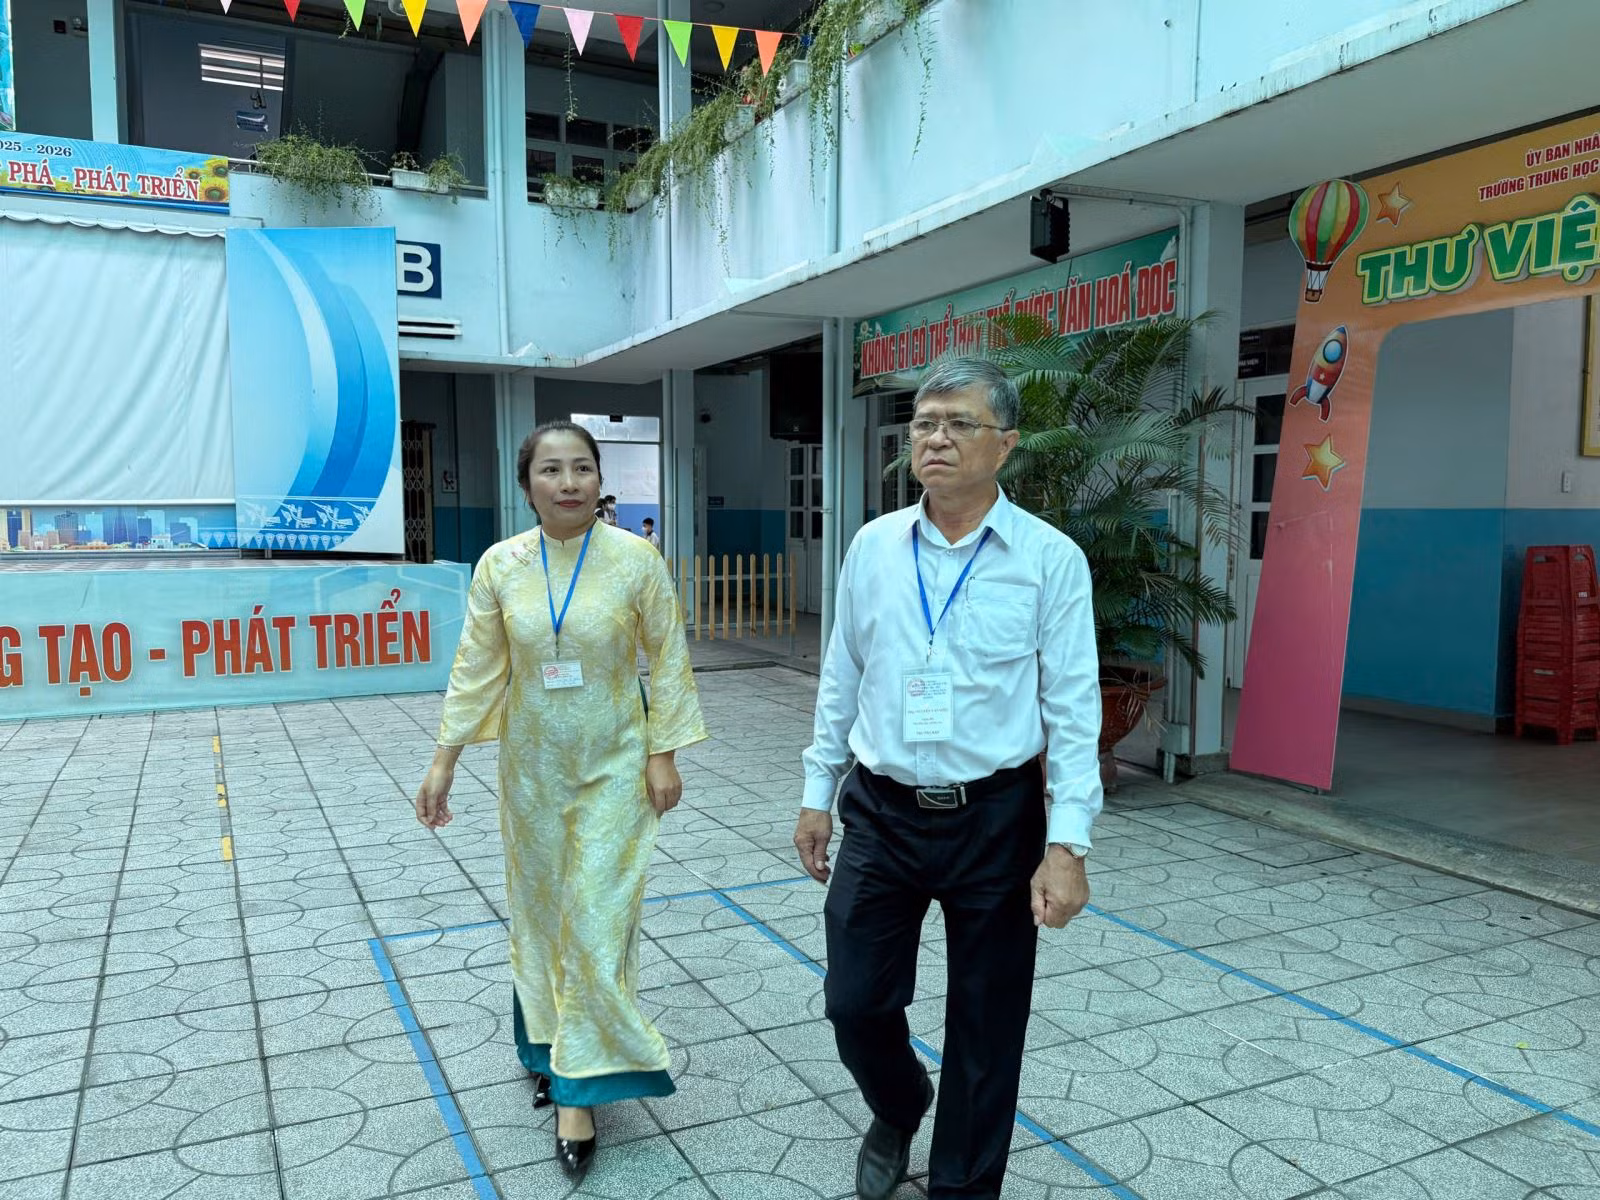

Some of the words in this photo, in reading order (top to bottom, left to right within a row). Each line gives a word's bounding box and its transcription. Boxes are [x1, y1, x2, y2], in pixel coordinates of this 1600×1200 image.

[37, 144, 73, 157] 2026
[1526, 149, 1543, 167] ỦY
[1545, 143, 1571, 162] BAN
[8, 158, 54, 185] PHÁ
[75, 165, 131, 193] PHÁT
[137, 166, 199, 200] TRIỂN
[1479, 177, 1525, 201] TRƯỜNG
[1528, 166, 1569, 189] TRUNG
[1572, 158, 1599, 179] HỌC
[396, 243, 434, 292] B
[1358, 224, 1480, 305] THƯ
[861, 333, 896, 378] KHÔNG
[898, 322, 911, 371] GÌ
[911, 317, 927, 369] CÓ
[928, 304, 952, 366] THỂ
[1057, 276, 1092, 336] VĂN
[1094, 261, 1132, 329] HOÁ
[1136, 260, 1177, 325] ĐỌC
[38, 621, 132, 697] TẠO
[149, 648, 166, 660] -
[181, 604, 296, 678] PHÁT
[308, 588, 431, 669] TRIỂN
